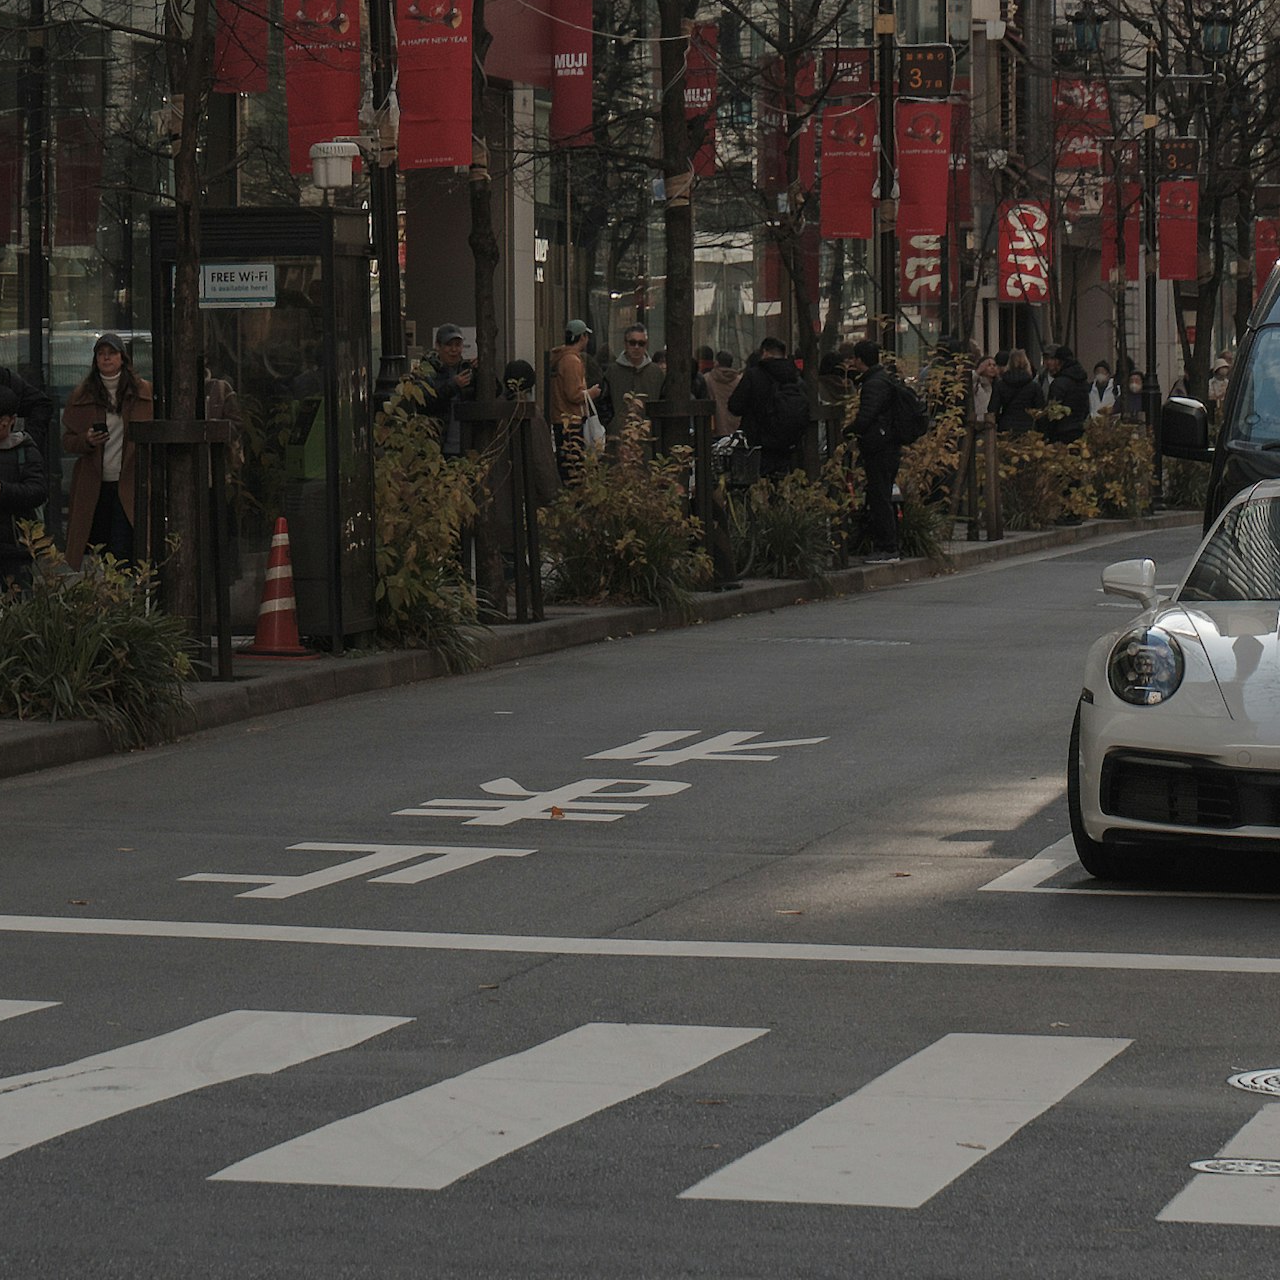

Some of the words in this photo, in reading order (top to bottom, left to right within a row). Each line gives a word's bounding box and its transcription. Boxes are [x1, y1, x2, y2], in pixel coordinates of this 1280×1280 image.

[408, 38, 431, 46] HAPPY
[450, 35, 468, 44] YEAR
[554, 52, 588, 69] MUJI
[1005, 203, 1049, 298] CAFE
[211, 271, 236, 283] FREE
[238, 271, 269, 282] Wi-Fi
[219, 284, 249, 292] available
